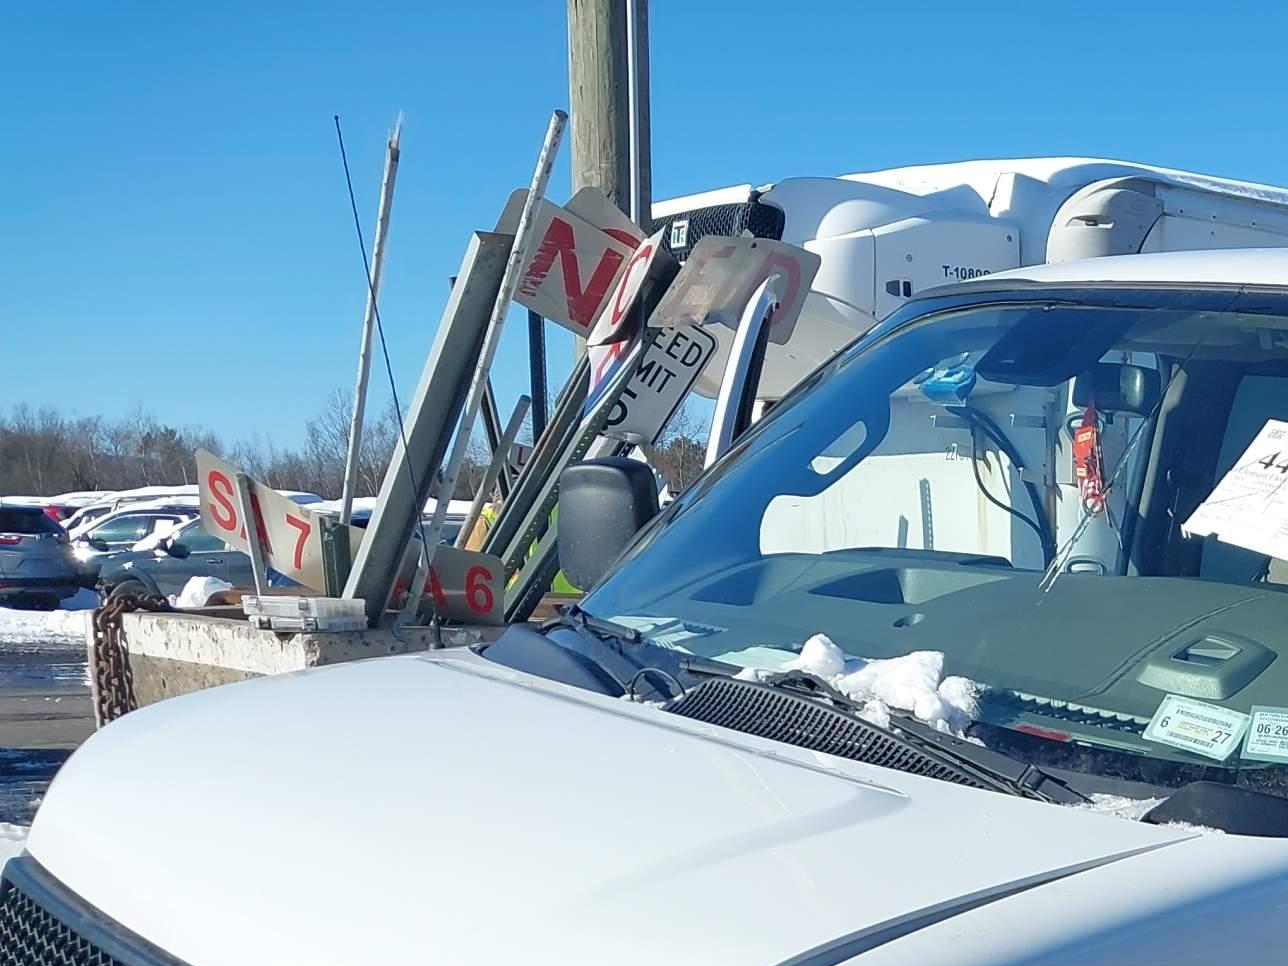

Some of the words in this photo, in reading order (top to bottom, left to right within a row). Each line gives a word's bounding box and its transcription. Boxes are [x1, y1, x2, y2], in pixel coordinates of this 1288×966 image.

[652, 326, 703, 368] EED
[636, 360, 677, 393] MIT
[1160, 716, 1171, 728] 6
[1211, 730, 1232, 745] 27
